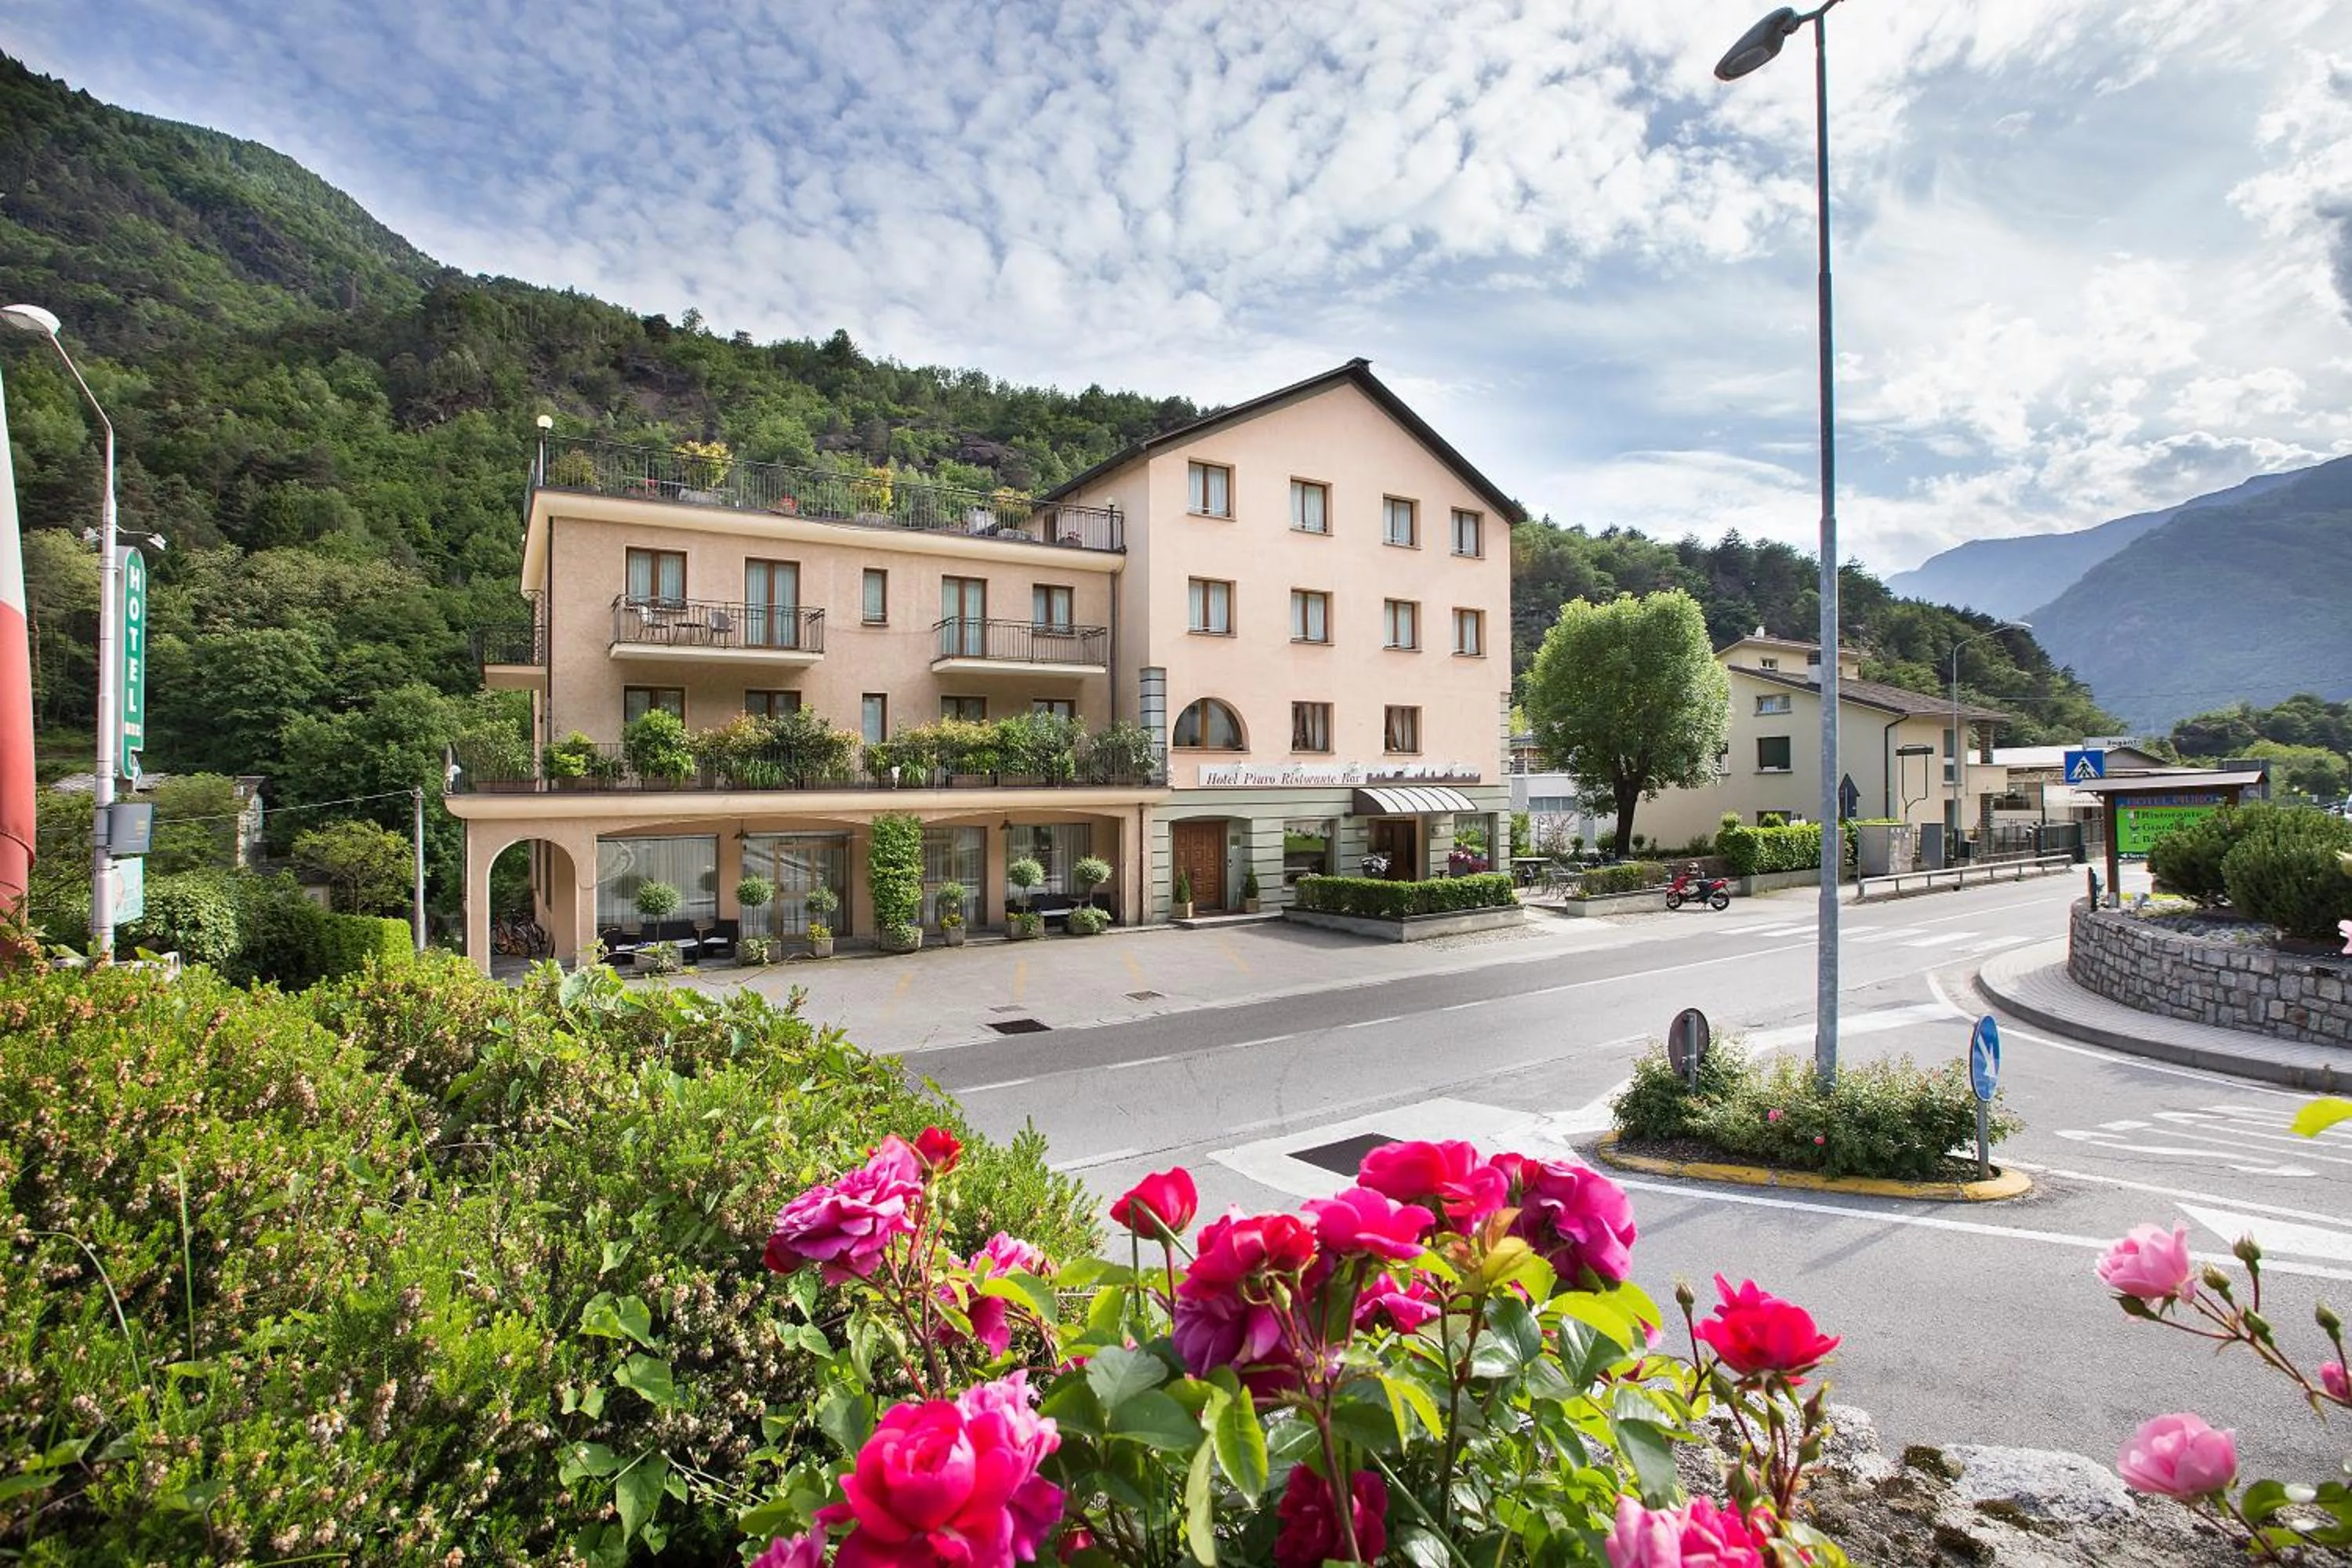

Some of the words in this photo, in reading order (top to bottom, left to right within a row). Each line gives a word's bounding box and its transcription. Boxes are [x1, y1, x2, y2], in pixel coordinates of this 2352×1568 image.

[129, 564, 140, 713] HOTEL
[1207, 772, 1238, 785] Hotel
[1244, 772, 1276, 785] Piuro
[1282, 772, 1338, 785] Ristorante
[1341, 772, 1360, 783] Bar
